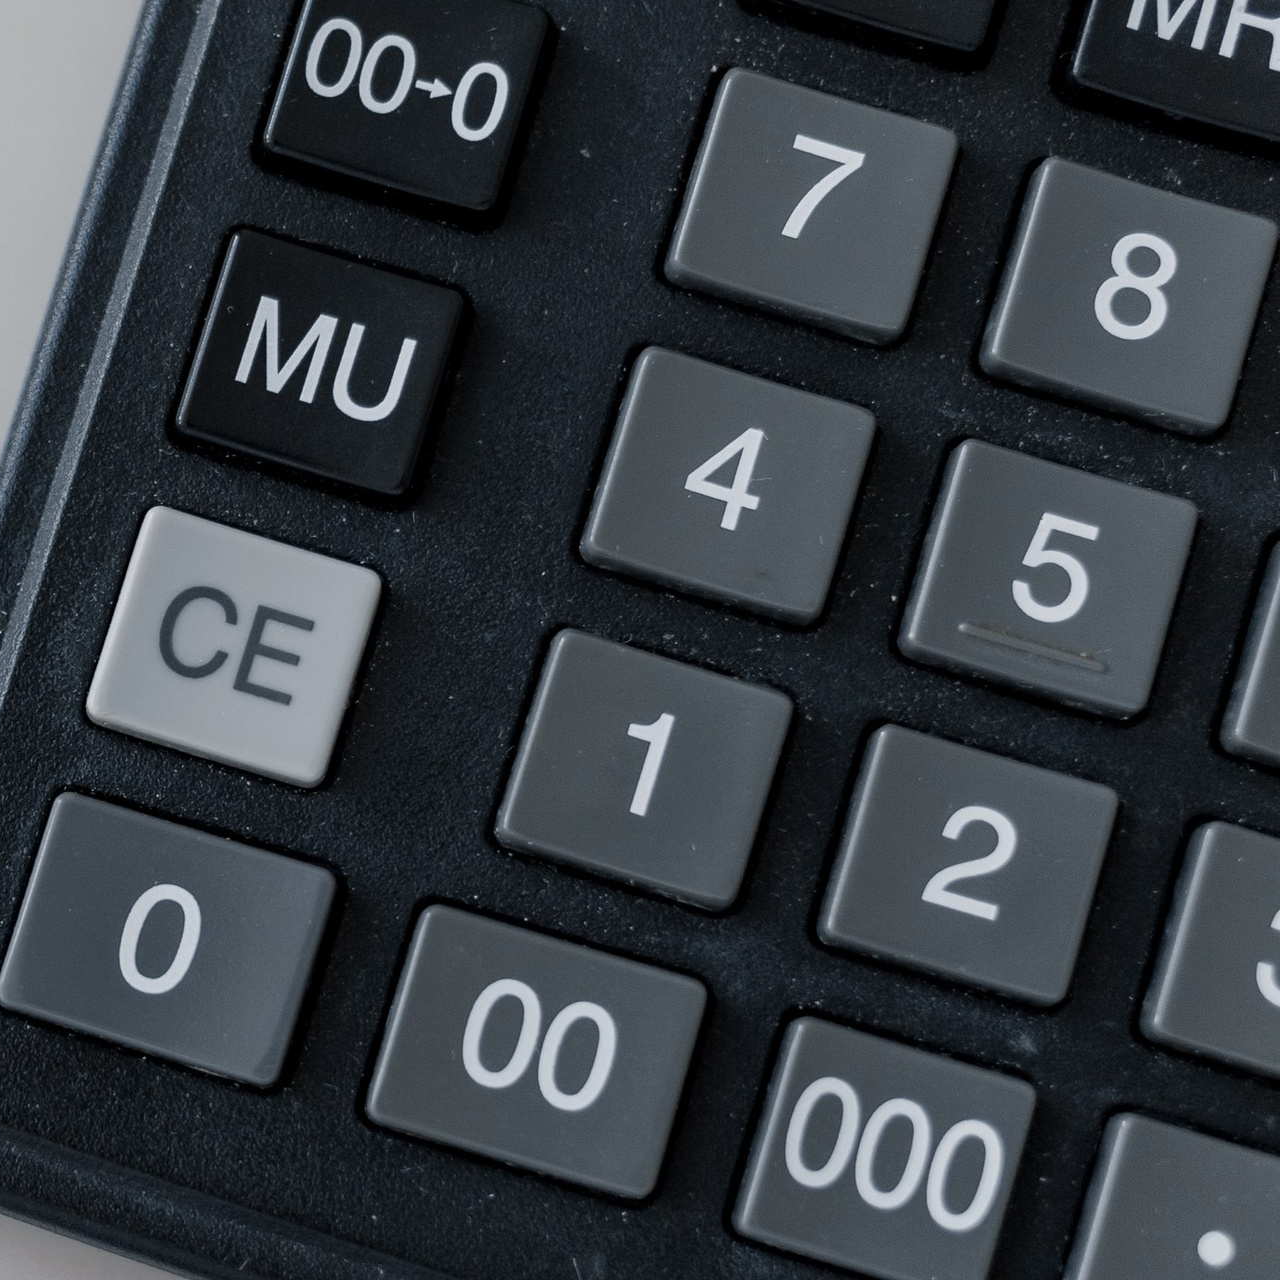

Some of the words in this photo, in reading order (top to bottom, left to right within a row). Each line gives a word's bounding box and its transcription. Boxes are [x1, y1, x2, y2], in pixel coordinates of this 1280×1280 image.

[782, 135, 865, 238] 7
[1095, 233, 1177, 340] 8
[235, 296, 417, 421] MU
[685, 428, 764, 530] 4
[1013, 513, 1099, 622] 5
[159, 586, 315, 705] CE
[628, 713, 674, 816] 1
[922, 806, 1016, 920] 2
[119, 884, 201, 994] 0
[463, 979, 616, 1111] 00
[784, 1076, 1004, 1232] 000
